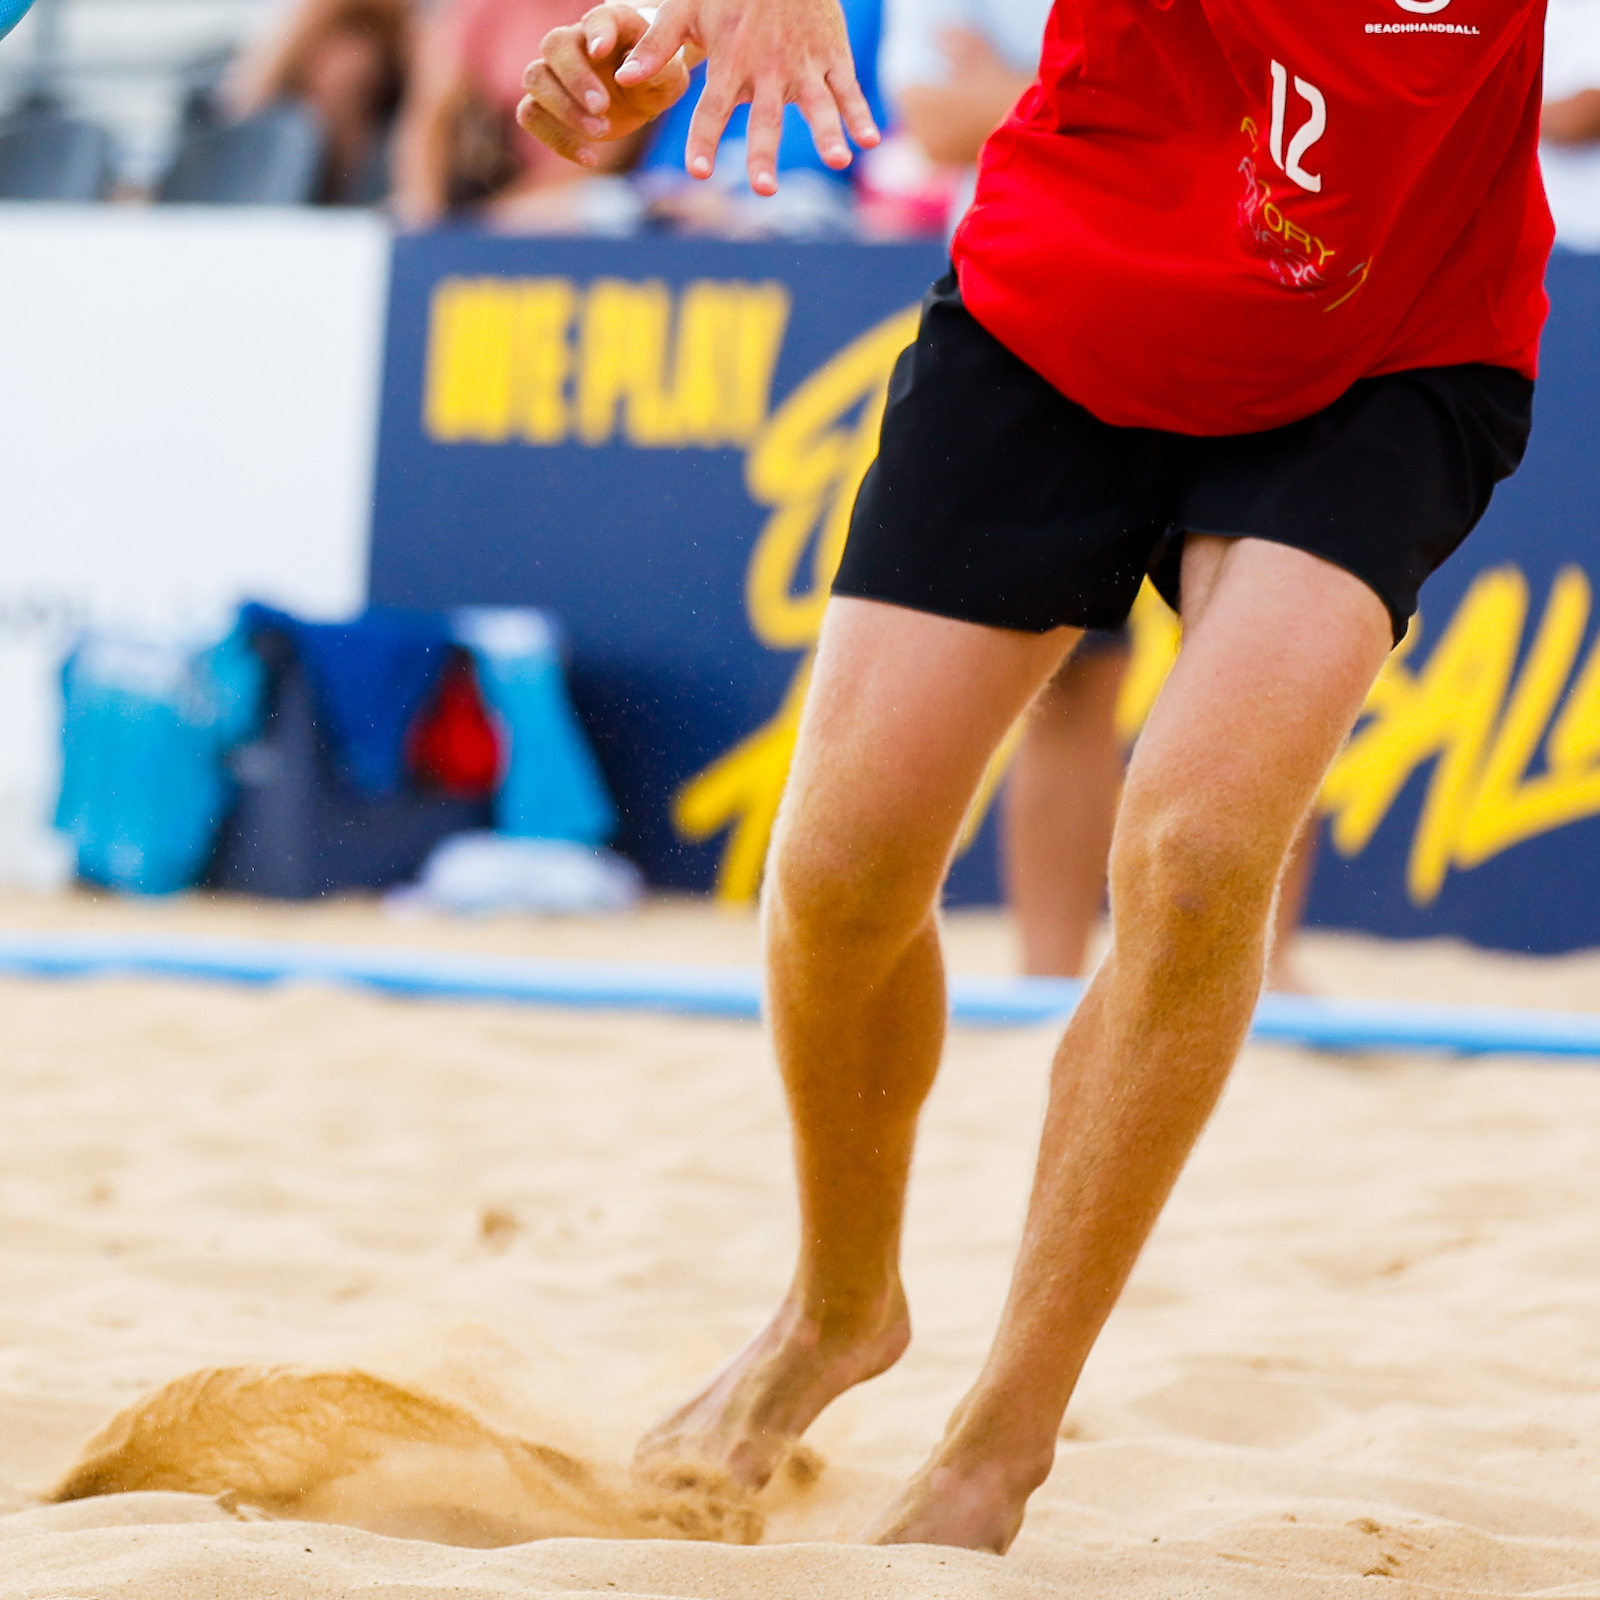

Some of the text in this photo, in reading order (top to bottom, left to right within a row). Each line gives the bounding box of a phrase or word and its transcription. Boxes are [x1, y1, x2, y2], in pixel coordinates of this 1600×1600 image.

[1364, 22, 1481, 36] BEACHHANDBALL
[1269, 58, 1327, 194] 12
[425, 276, 790, 448] WE PLAY
